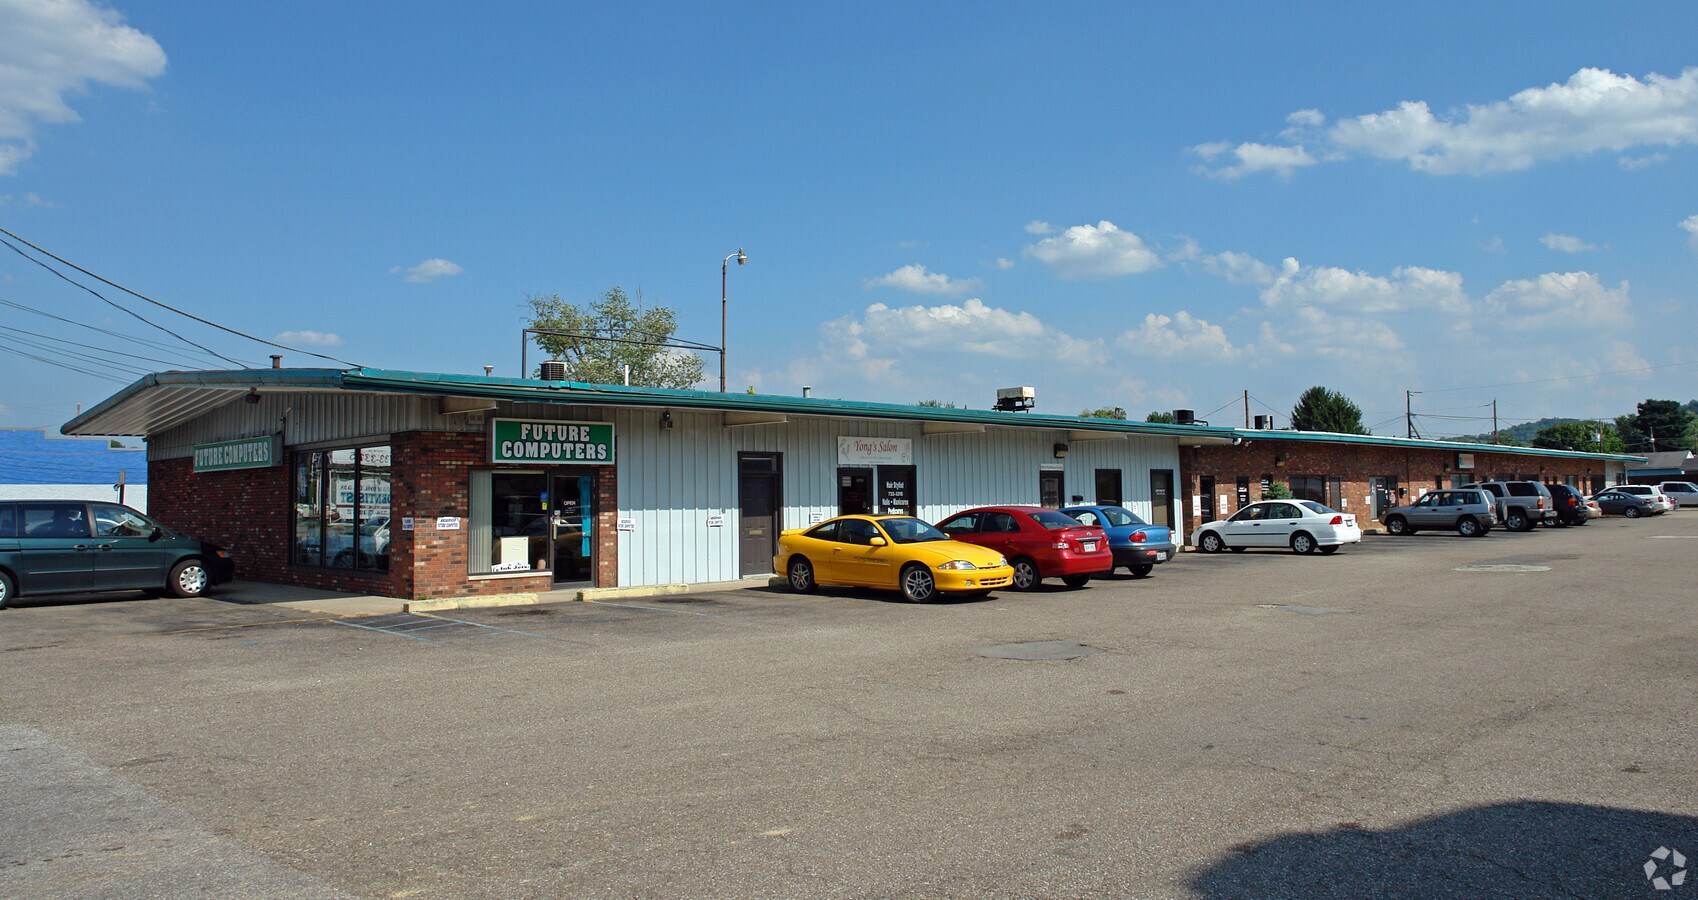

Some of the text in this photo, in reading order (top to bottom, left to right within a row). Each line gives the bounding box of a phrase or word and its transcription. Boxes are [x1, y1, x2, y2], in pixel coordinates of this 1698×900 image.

[521, 423, 590, 442] FUTURE
[195, 441, 269, 467] FUTURE COMPUTERS
[501, 439, 607, 460] COMPUTERS
[854, 439, 898, 455] Yong's Salon
